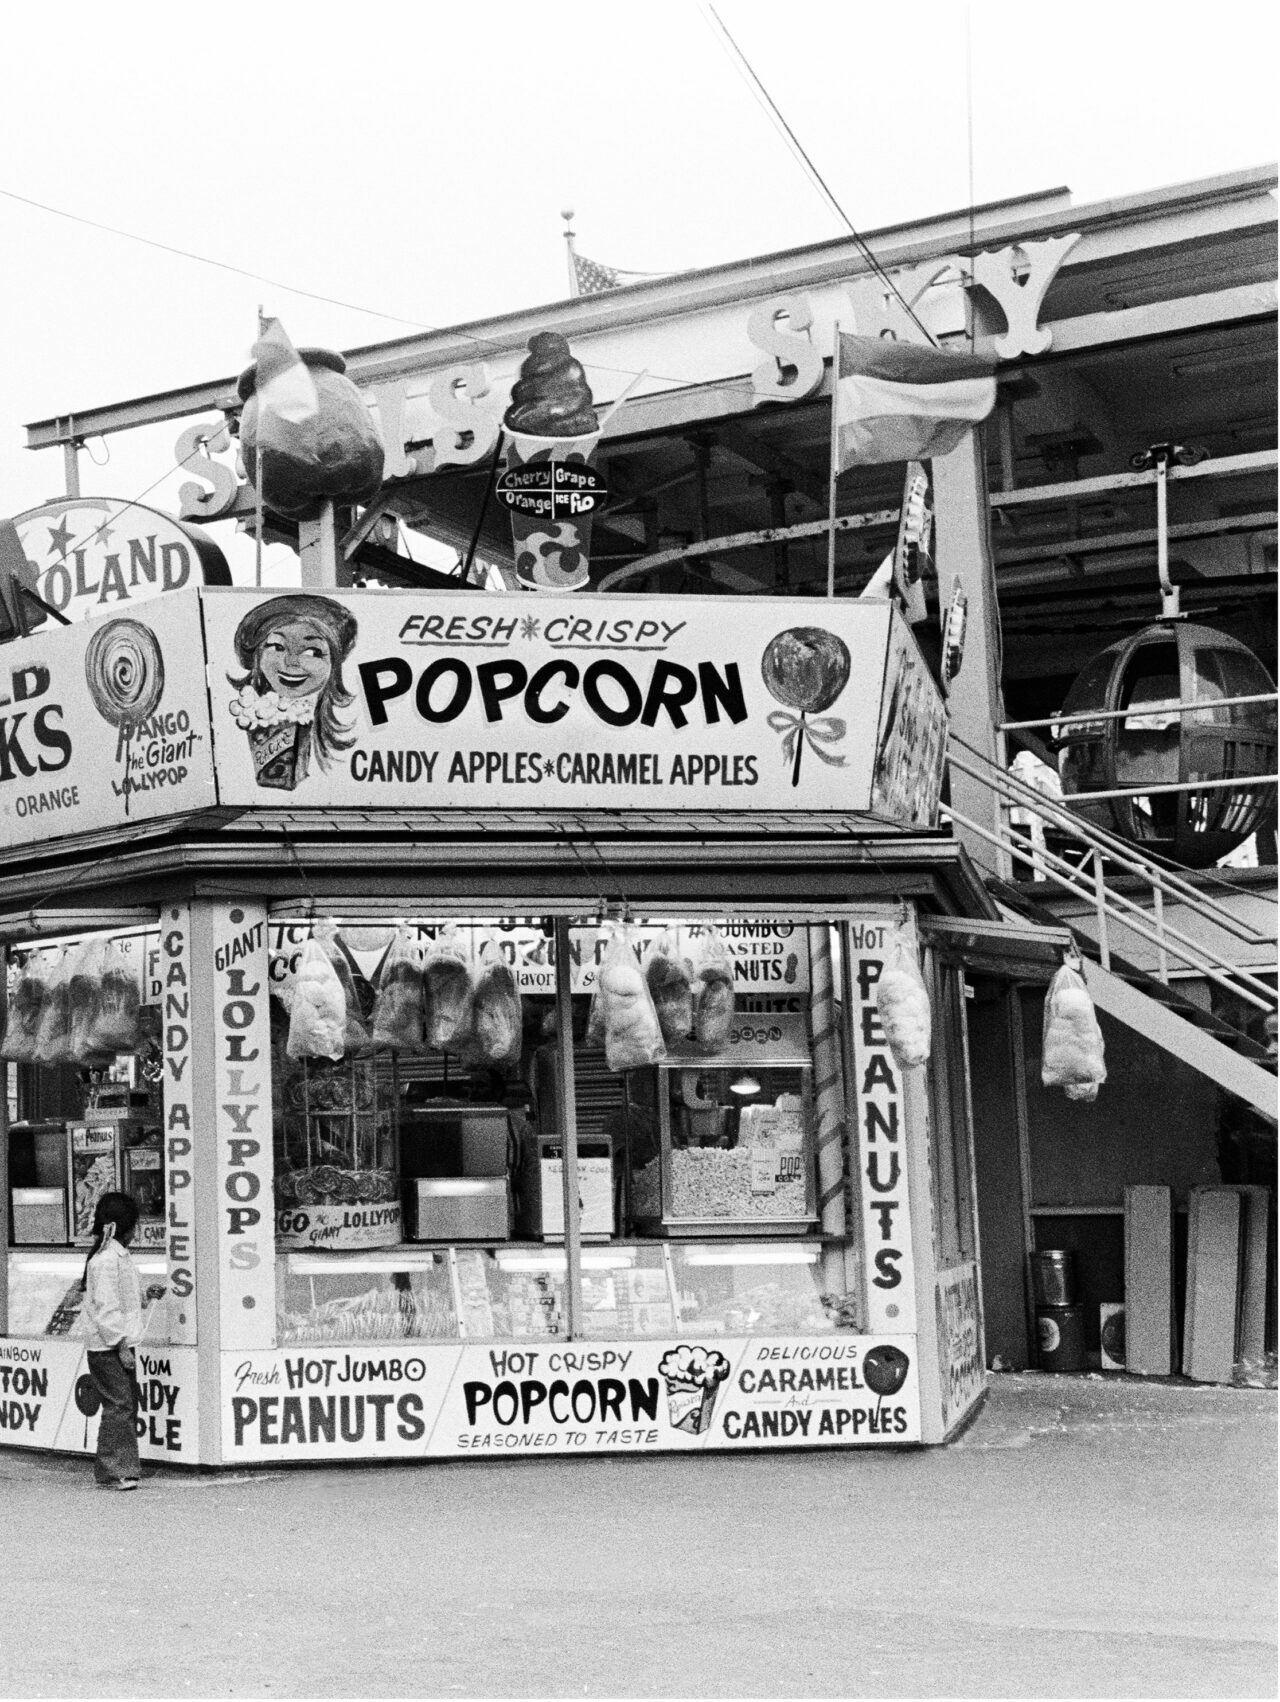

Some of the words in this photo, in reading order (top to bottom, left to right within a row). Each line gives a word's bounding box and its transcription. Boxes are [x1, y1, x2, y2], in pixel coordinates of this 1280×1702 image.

[505, 471, 550, 487] Cherry
[556, 468, 596, 488] Grape
[506, 492, 552, 514] Orange
[555, 494, 569, 504] ICE
[44, 534, 191, 612] OLAND
[397, 614, 519, 640] FRESH
[543, 616, 688, 643] CRISPY
[357, 657, 749, 730] POPCORN
[111, 766, 188, 797] LOLLYPOP
[350, 749, 439, 784] CANDY
[448, 750, 543, 785] APPLES
[556, 752, 663, 785] CARAMEL
[669, 754, 759, 786] APPLES
[15, 785, 81, 817] ORANGE
[215, 921, 264, 972] GIANT
[852, 926, 887, 950] HOT
[732, 960, 783, 982] NUTS
[163, 930, 189, 1082] CANDY
[222, 969, 261, 1271] LOLLYPOPS
[856, 959, 905, 1290] PEANUTS
[167, 1103, 194, 1297] APPLES
[279, 1210, 311, 1233] GO
[140, 1355, 172, 1376] YUM
[489, 1350, 539, 1378] HOT
[548, 1350, 633, 1373] CRISPY
[756, 1345, 859, 1360] DELICIOUS
[234, 1360, 282, 1392] Fresh
[285, 1357, 337, 1390] HOT
[337, 1354, 427, 1384] JUMBO
[738, 1366, 865, 1394] CARAMEL
[137, 1379, 181, 1416] NDY
[463, 1377, 660, 1426] POPCORN
[231, 1393, 426, 1446] PEANUTS
[723, 1409, 813, 1439] CANDY
[818, 1406, 908, 1436] APPLES
[457, 1432, 558, 1449] SEASONED
[565, 1431, 588, 1446] TO
[595, 1429, 660, 1445] TASTE
